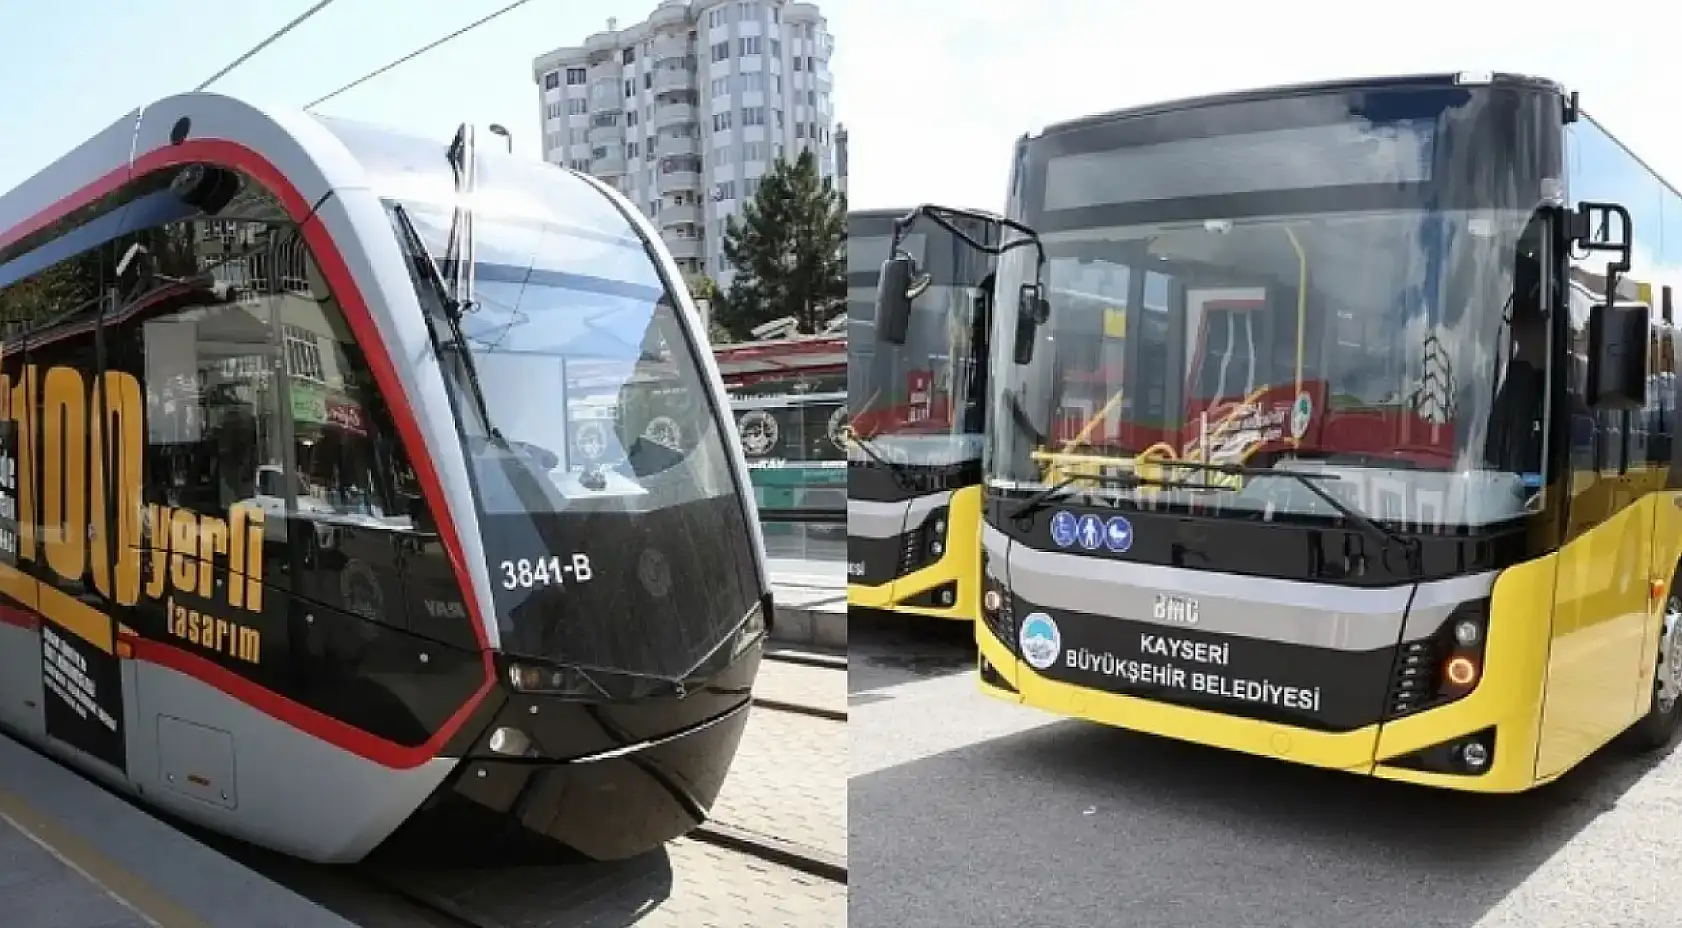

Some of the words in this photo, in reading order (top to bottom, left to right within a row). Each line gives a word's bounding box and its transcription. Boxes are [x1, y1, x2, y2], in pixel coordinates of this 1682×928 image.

[0, 364, 143, 606] 100
[145, 501, 265, 613] yerli
[500, 553, 592, 590] 3841-B
[167, 596, 261, 664] tasarım
[1140, 632, 1230, 665] KAYSERİ
[1066, 647, 1186, 687] BÜYÜKŞEHİR
[1191, 672, 1320, 711] BELEDİYESİ
